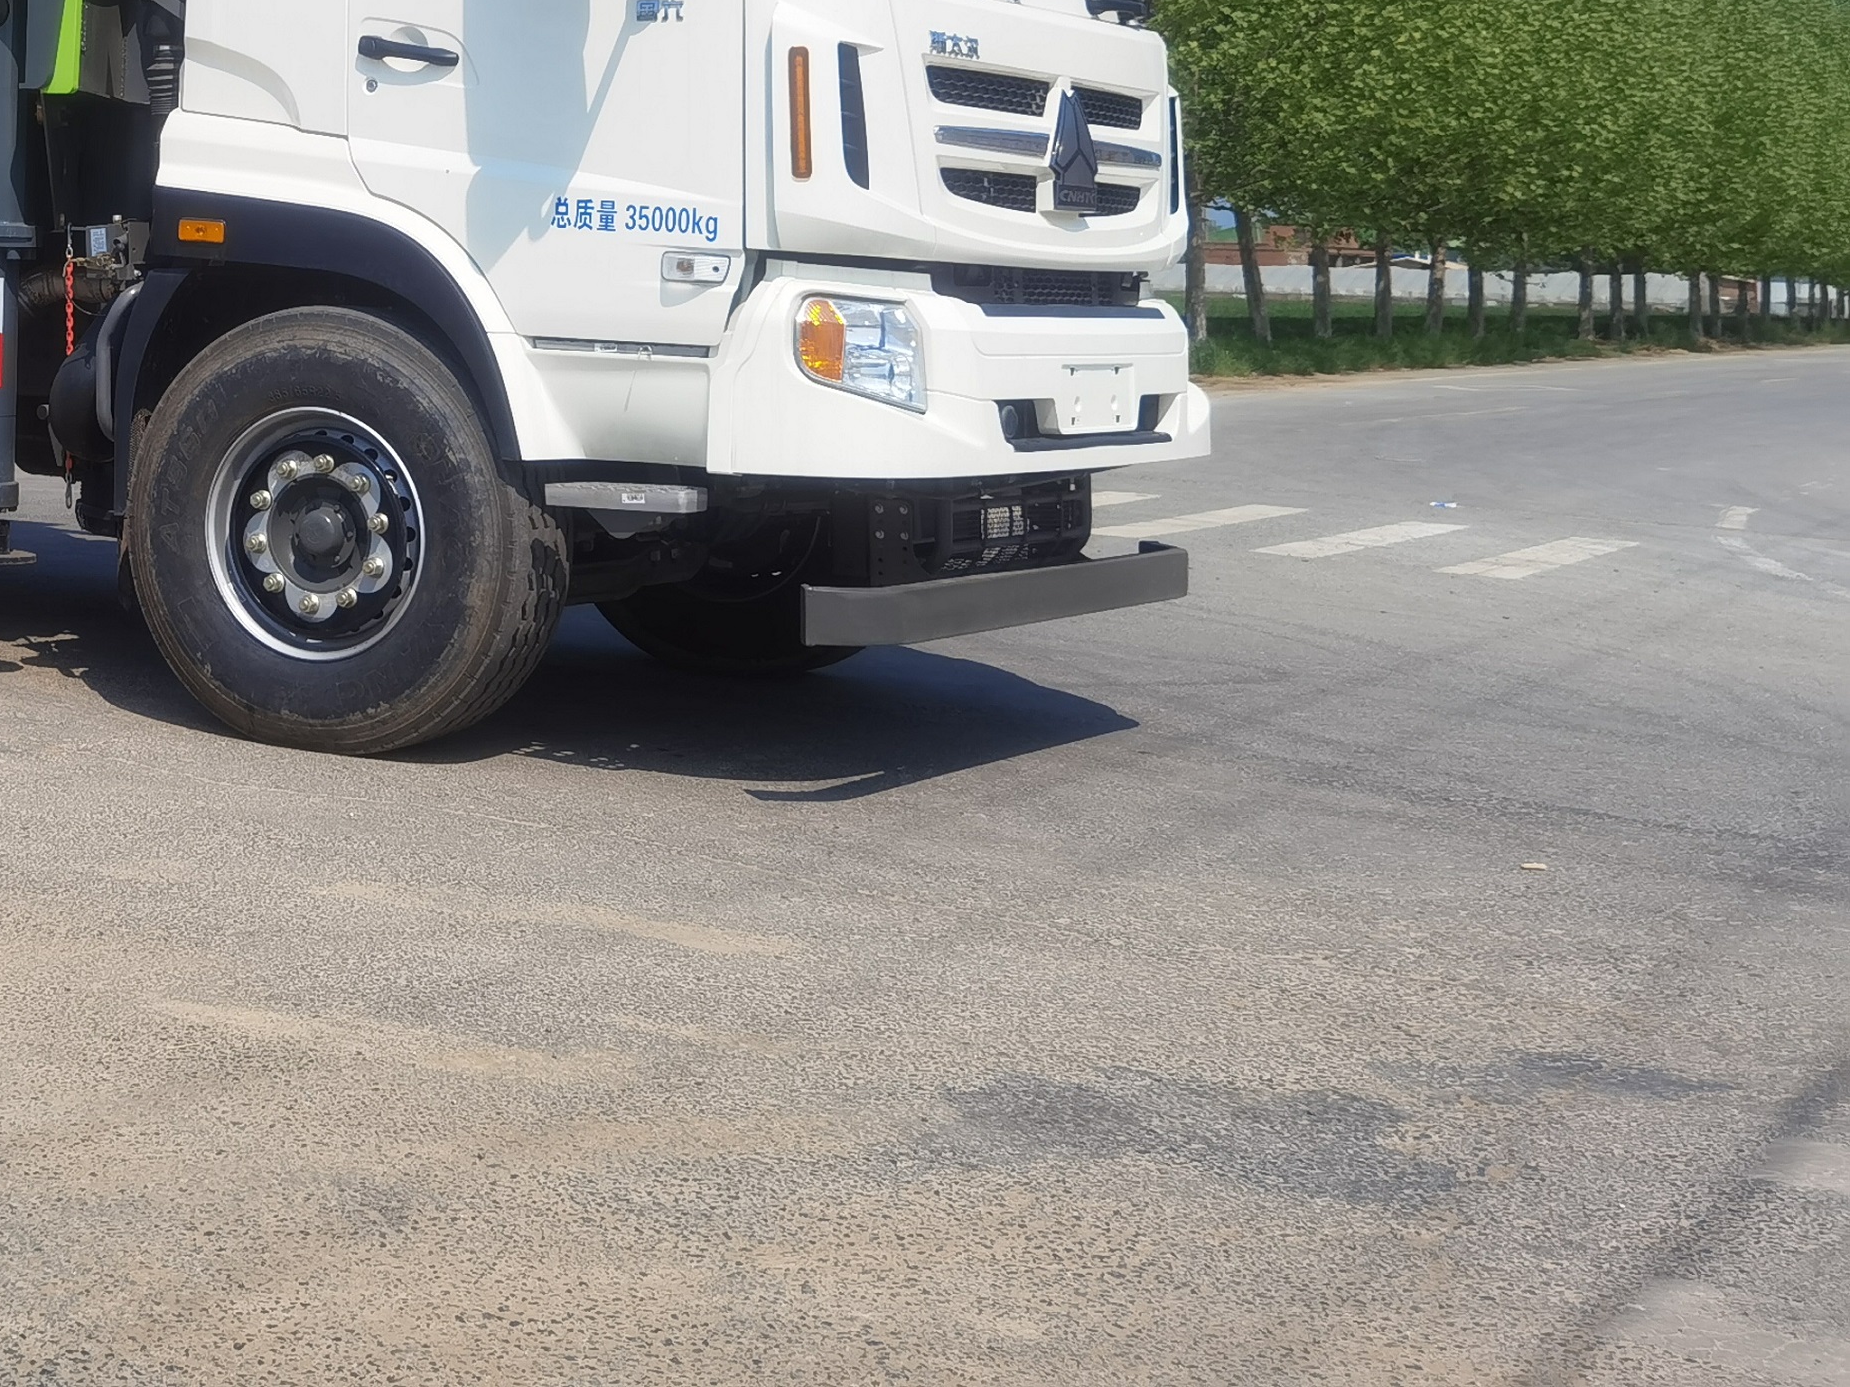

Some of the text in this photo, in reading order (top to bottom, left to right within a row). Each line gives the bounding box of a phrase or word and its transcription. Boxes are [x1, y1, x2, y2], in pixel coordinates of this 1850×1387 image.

[550, 196, 718, 243] 总质量 35000kg
